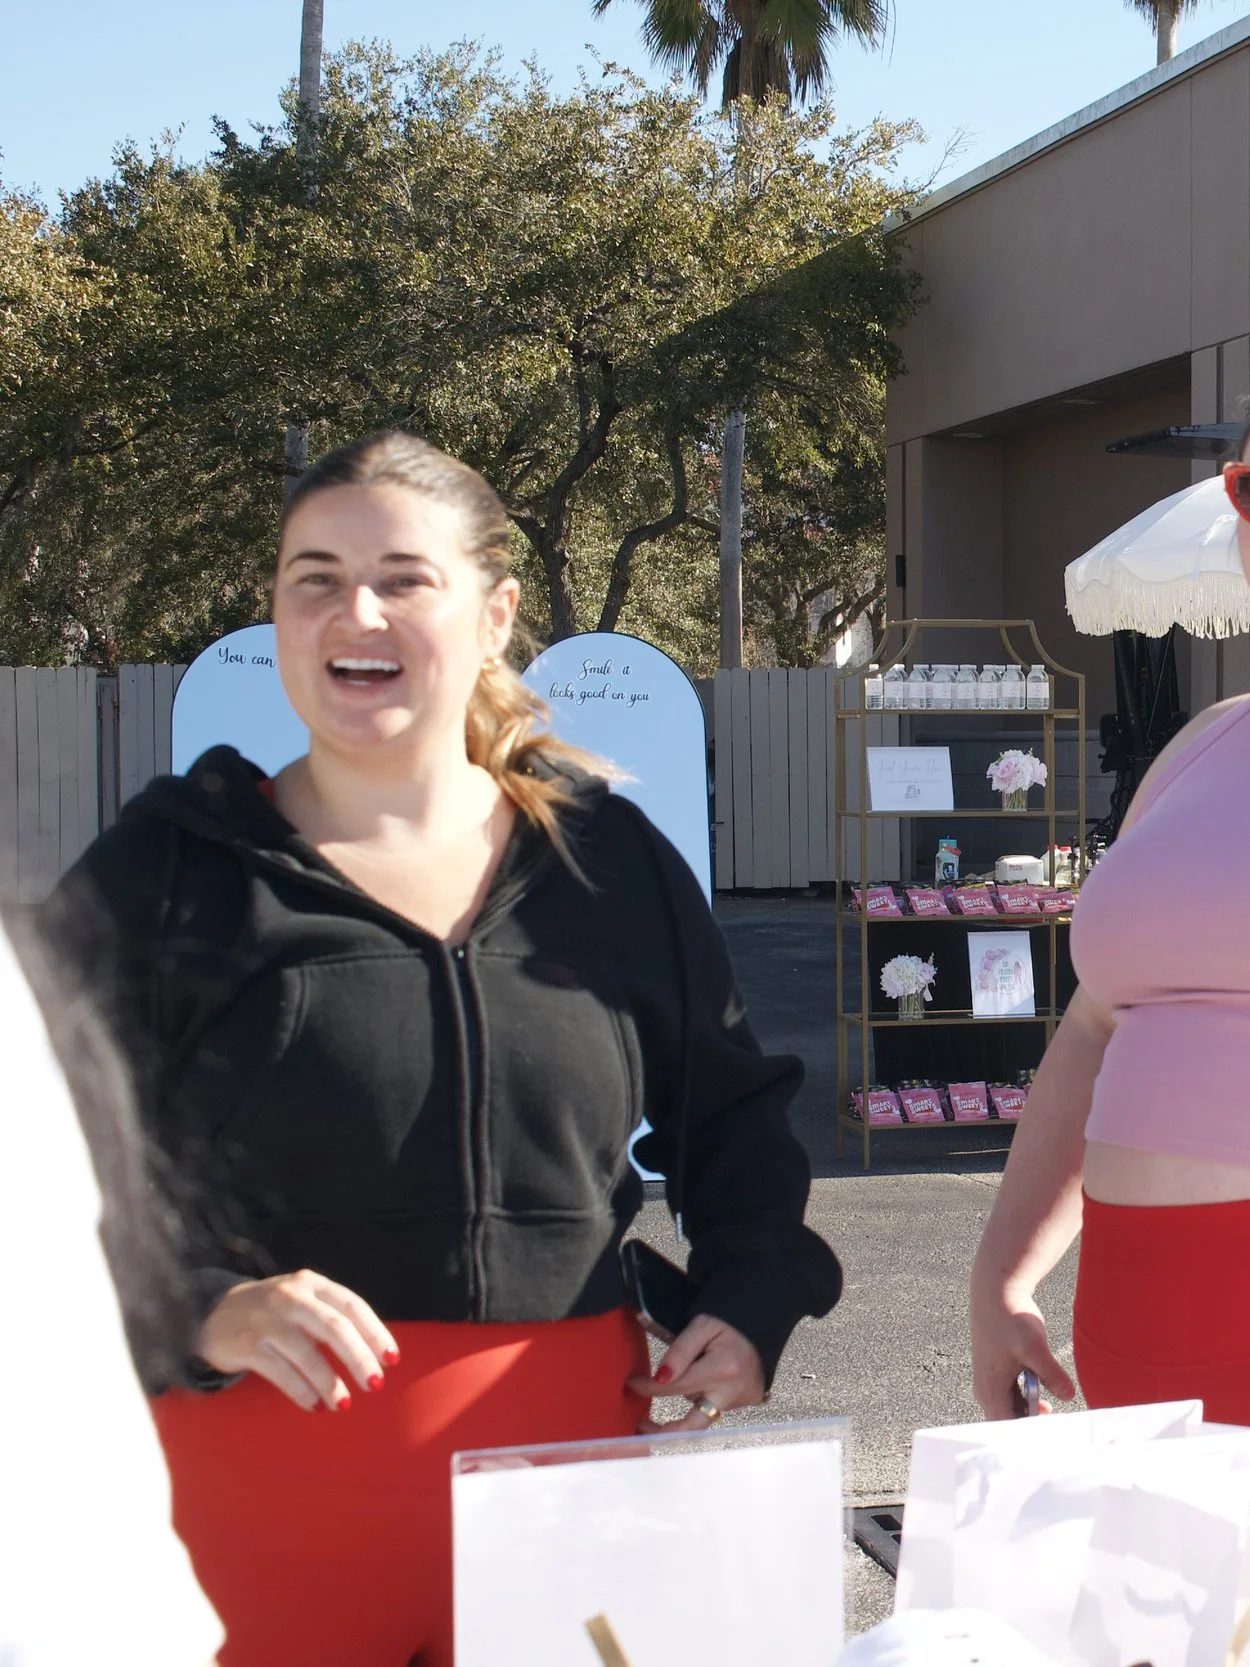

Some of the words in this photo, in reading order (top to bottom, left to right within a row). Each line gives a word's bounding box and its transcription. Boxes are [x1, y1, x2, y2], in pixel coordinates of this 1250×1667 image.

[218, 646, 246, 665] You
[251, 656, 278, 668] can
[577, 658, 613, 681] Smile
[622, 665, 631, 676] it
[549, 682, 576, 700] looks
[576, 682, 612, 707] good
[611, 692, 625, 700] on
[626, 692, 651, 709] you
